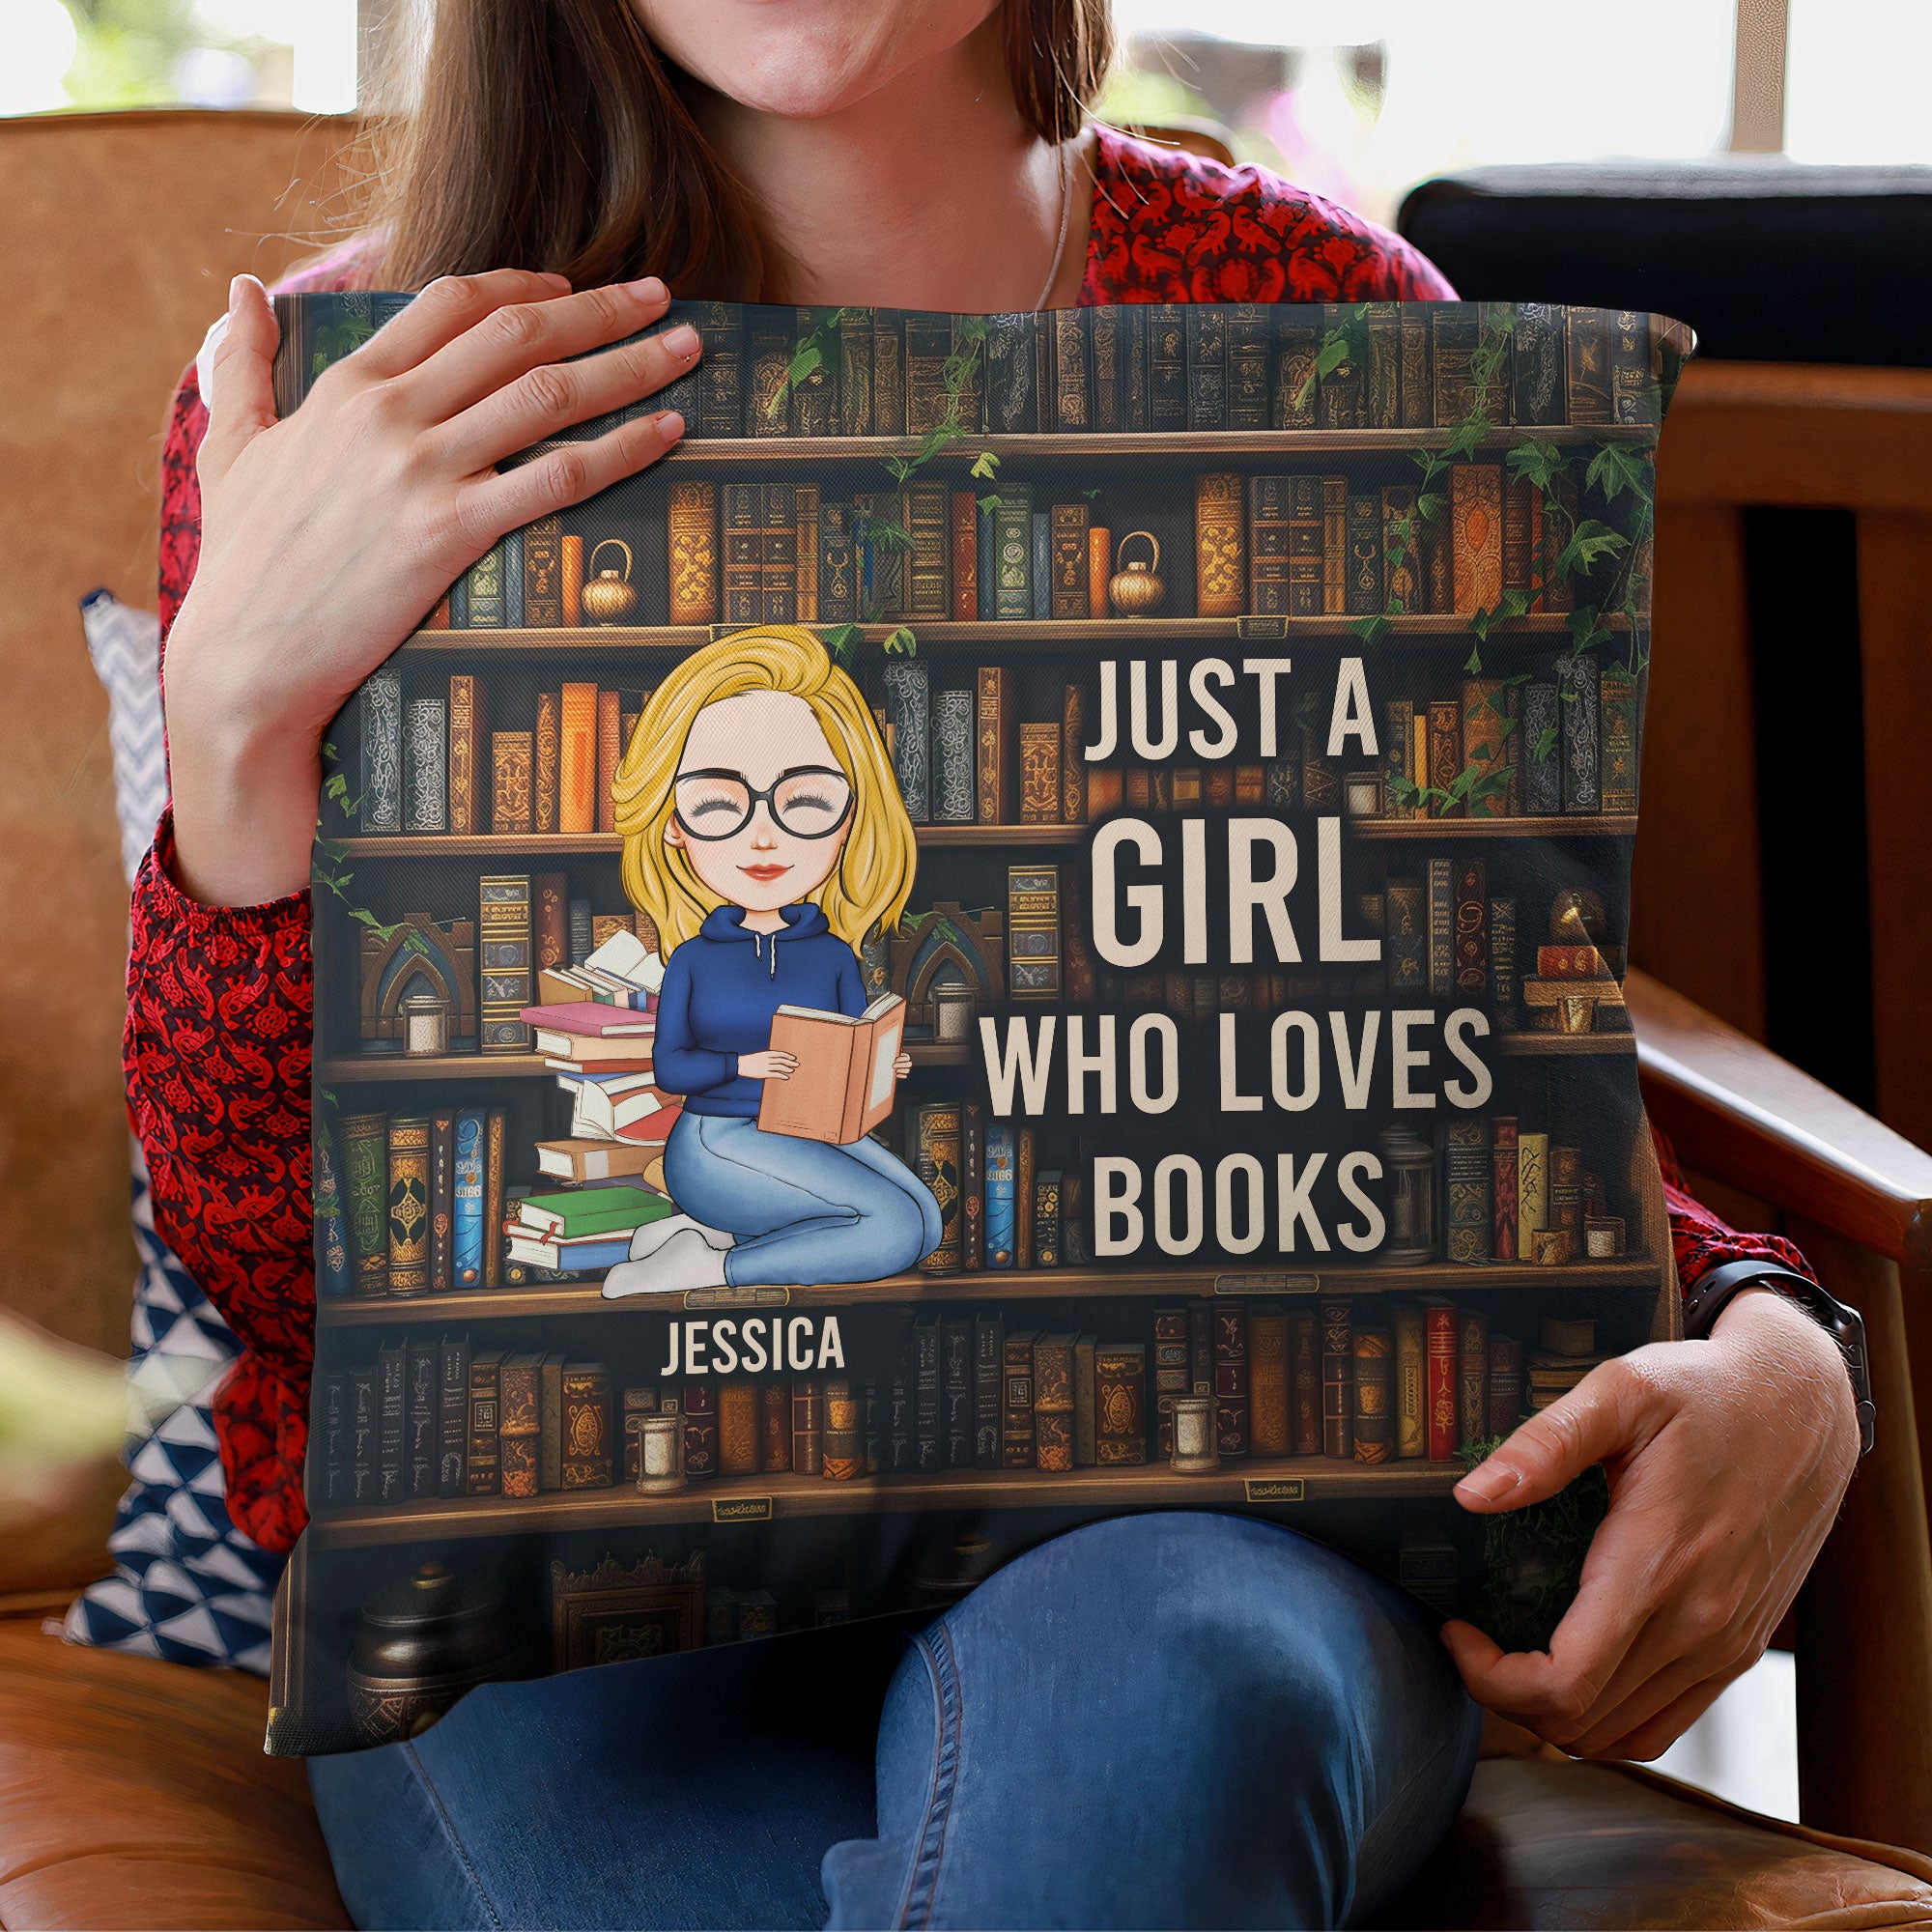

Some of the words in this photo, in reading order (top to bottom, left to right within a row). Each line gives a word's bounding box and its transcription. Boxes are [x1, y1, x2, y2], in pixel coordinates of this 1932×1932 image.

[1084, 657, 1292, 761] JUST
[1326, 657, 1379, 756] A
[1091, 816, 1381, 968] GIRL
[979, 1012, 1179, 1117] WHO
[1219, 1009, 1493, 1113] LOVES
[1094, 1151, 1387, 1257] BOOKS
[660, 1316, 846, 1377] JESSICA
